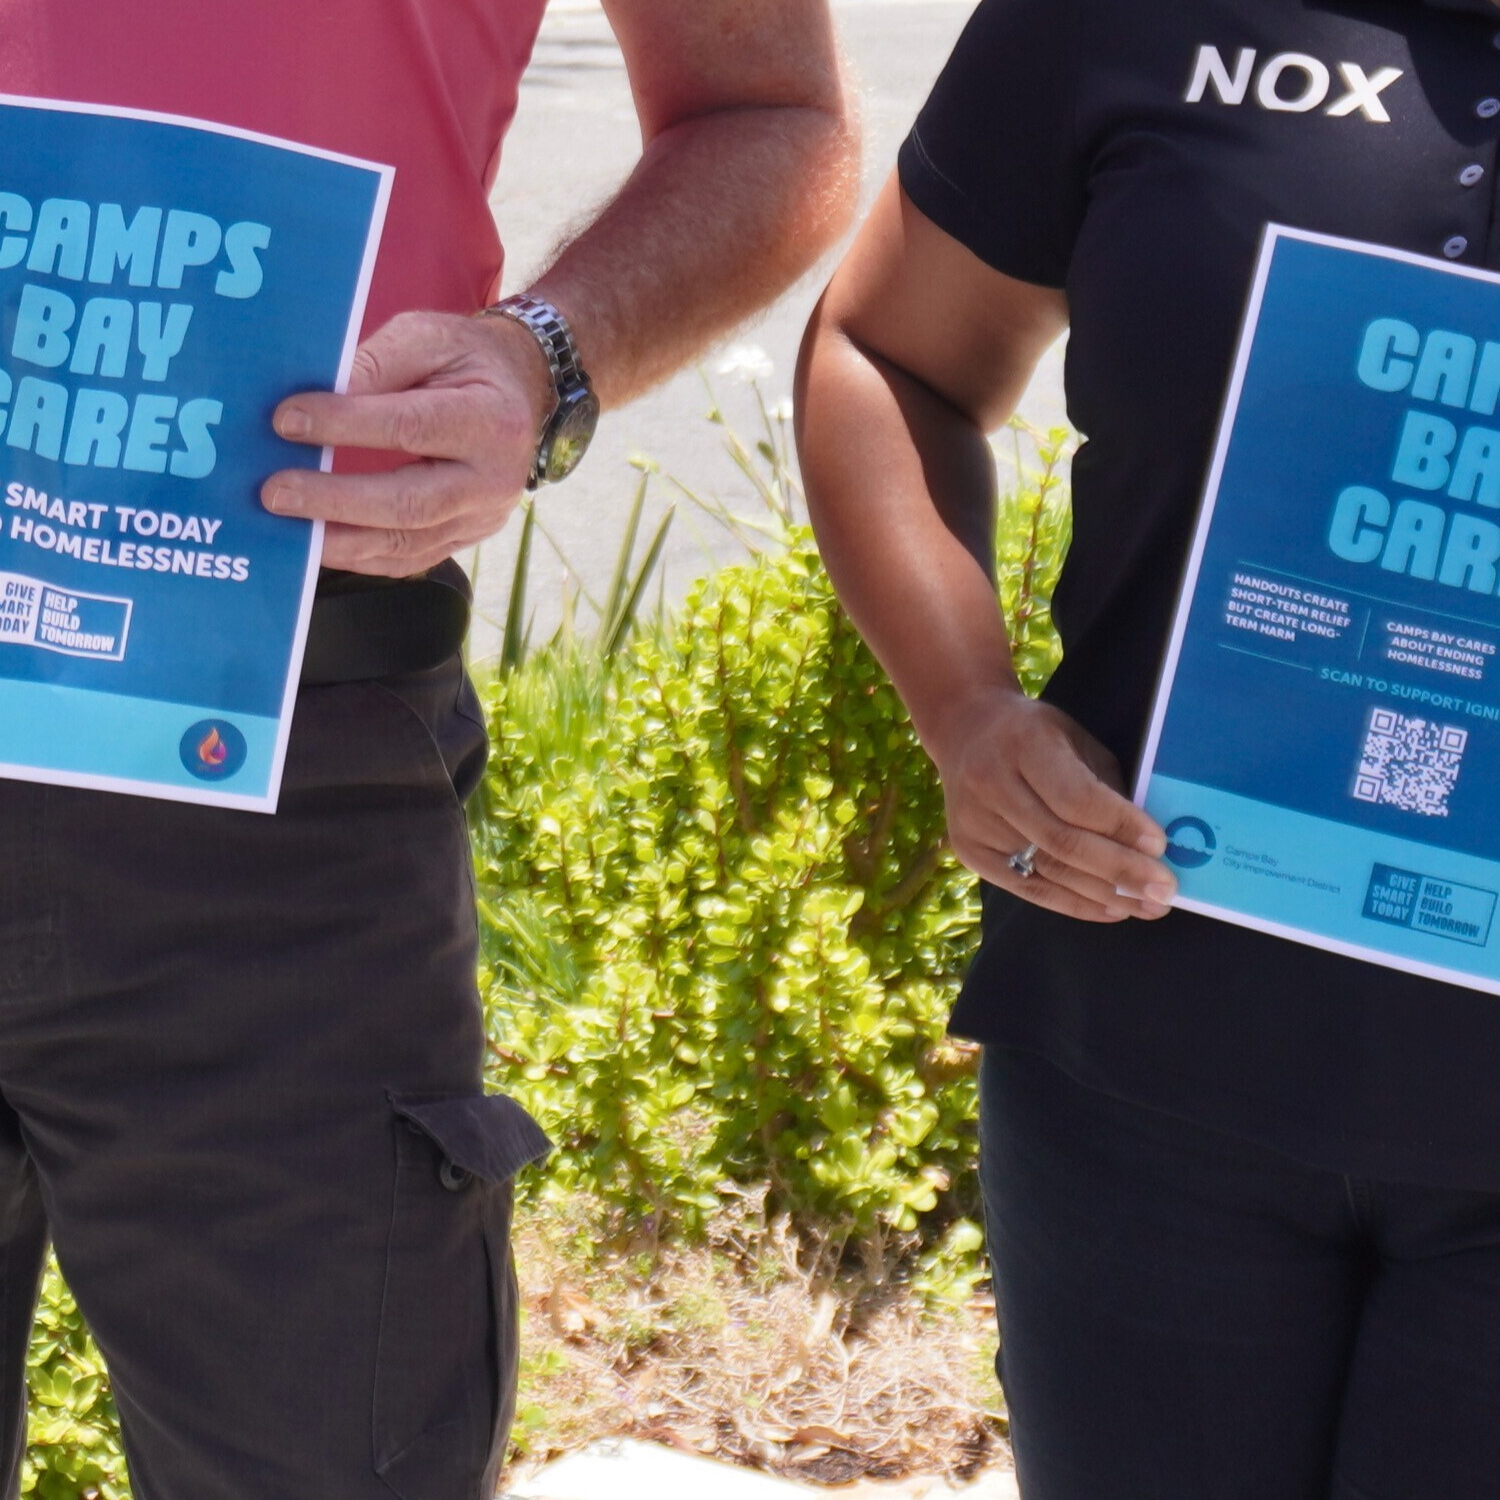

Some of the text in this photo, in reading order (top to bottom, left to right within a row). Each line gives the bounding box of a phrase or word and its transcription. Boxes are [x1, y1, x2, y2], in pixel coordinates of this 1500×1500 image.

[1184, 44, 1404, 123] NOX
[11, 283, 194, 382] BAY
[5, 482, 109, 530] SMART
[115, 506, 223, 545] TODAY
[10, 515, 250, 582] HOMELESSNESS
[6, 581, 36, 601] GIVE
[45, 592, 78, 613] HELP
[1234, 573, 1349, 613] HANDOUTS CREATE
[42, 608, 80, 631] BUILD
[1228, 601, 1341, 638] BUT CREATE LONG-
[1231, 587, 1352, 628] SHORT-TERM RELIEF
[41, 624, 115, 652] TOMORROW
[1225, 613, 1296, 642] TERM HARM
[1386, 621, 1496, 655] CAMPS BAY CARES
[1387, 649, 1483, 680] HOMELESSNESS
[1391, 636, 1485, 666] ABOUT ENDING
[1320, 667, 1362, 688] SCAN
[1366, 677, 1388, 692] TO
[1391, 683, 1464, 711] SUPPORT
[1372, 884, 1414, 906] SMART
[1389, 873, 1417, 891] GIVE
[1424, 882, 1452, 897] HELP
[1370, 900, 1410, 920] TODAY
[1418, 911, 1480, 938] TOMORROW
